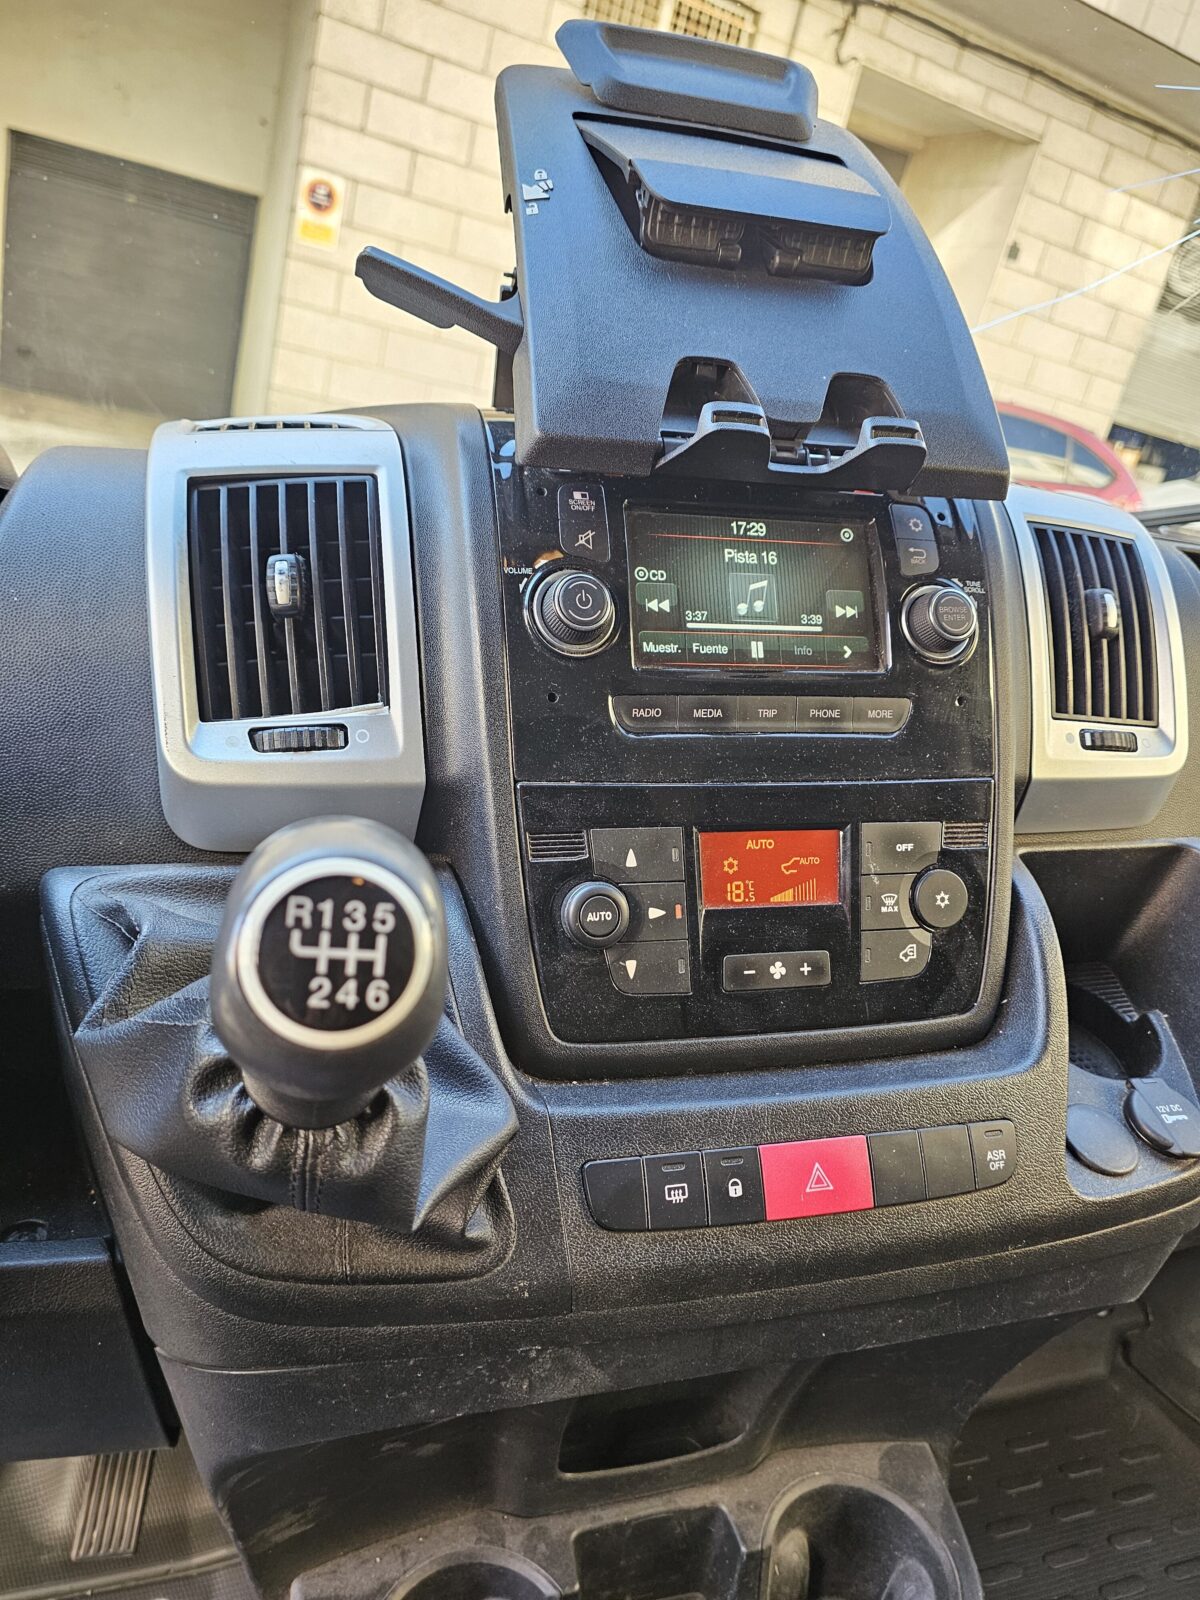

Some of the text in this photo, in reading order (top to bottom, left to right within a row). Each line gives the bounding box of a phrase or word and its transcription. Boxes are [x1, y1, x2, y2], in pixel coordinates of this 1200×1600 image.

[568, 498, 596, 506] SCREEN
[730, 521, 767, 537] 17:29
[724, 548, 778, 565] Pista 16
[503, 567, 533, 575] VOLUME
[649, 570, 667, 581] CD
[966, 580, 981, 588] TUNE
[964, 586, 986, 594] SCROLL
[939, 606, 968, 614] BROWSE
[685, 611, 708, 622] 3:37
[800, 614, 823, 625] 3:39
[943, 614, 967, 622] ENTER
[642, 642, 682, 654] Muestr.
[692, 643, 728, 655] Fuente
[794, 645, 813, 656] Info
[632, 708, 662, 718] RADIO
[693, 708, 723, 718] MEDIA
[757, 708, 778, 718] TRIP
[809, 709, 841, 718] PHONE
[867, 709, 893, 719] MORE
[746, 839, 775, 850] AUTO
[895, 843, 915, 852] OFF
[799, 857, 820, 865] AUTO
[586, 911, 612, 922] AUTO
[1155, 1104, 1183, 1113] 12V DC
[987, 1149, 1007, 1162] ASR
[989, 1160, 1005, 1171] OFF
